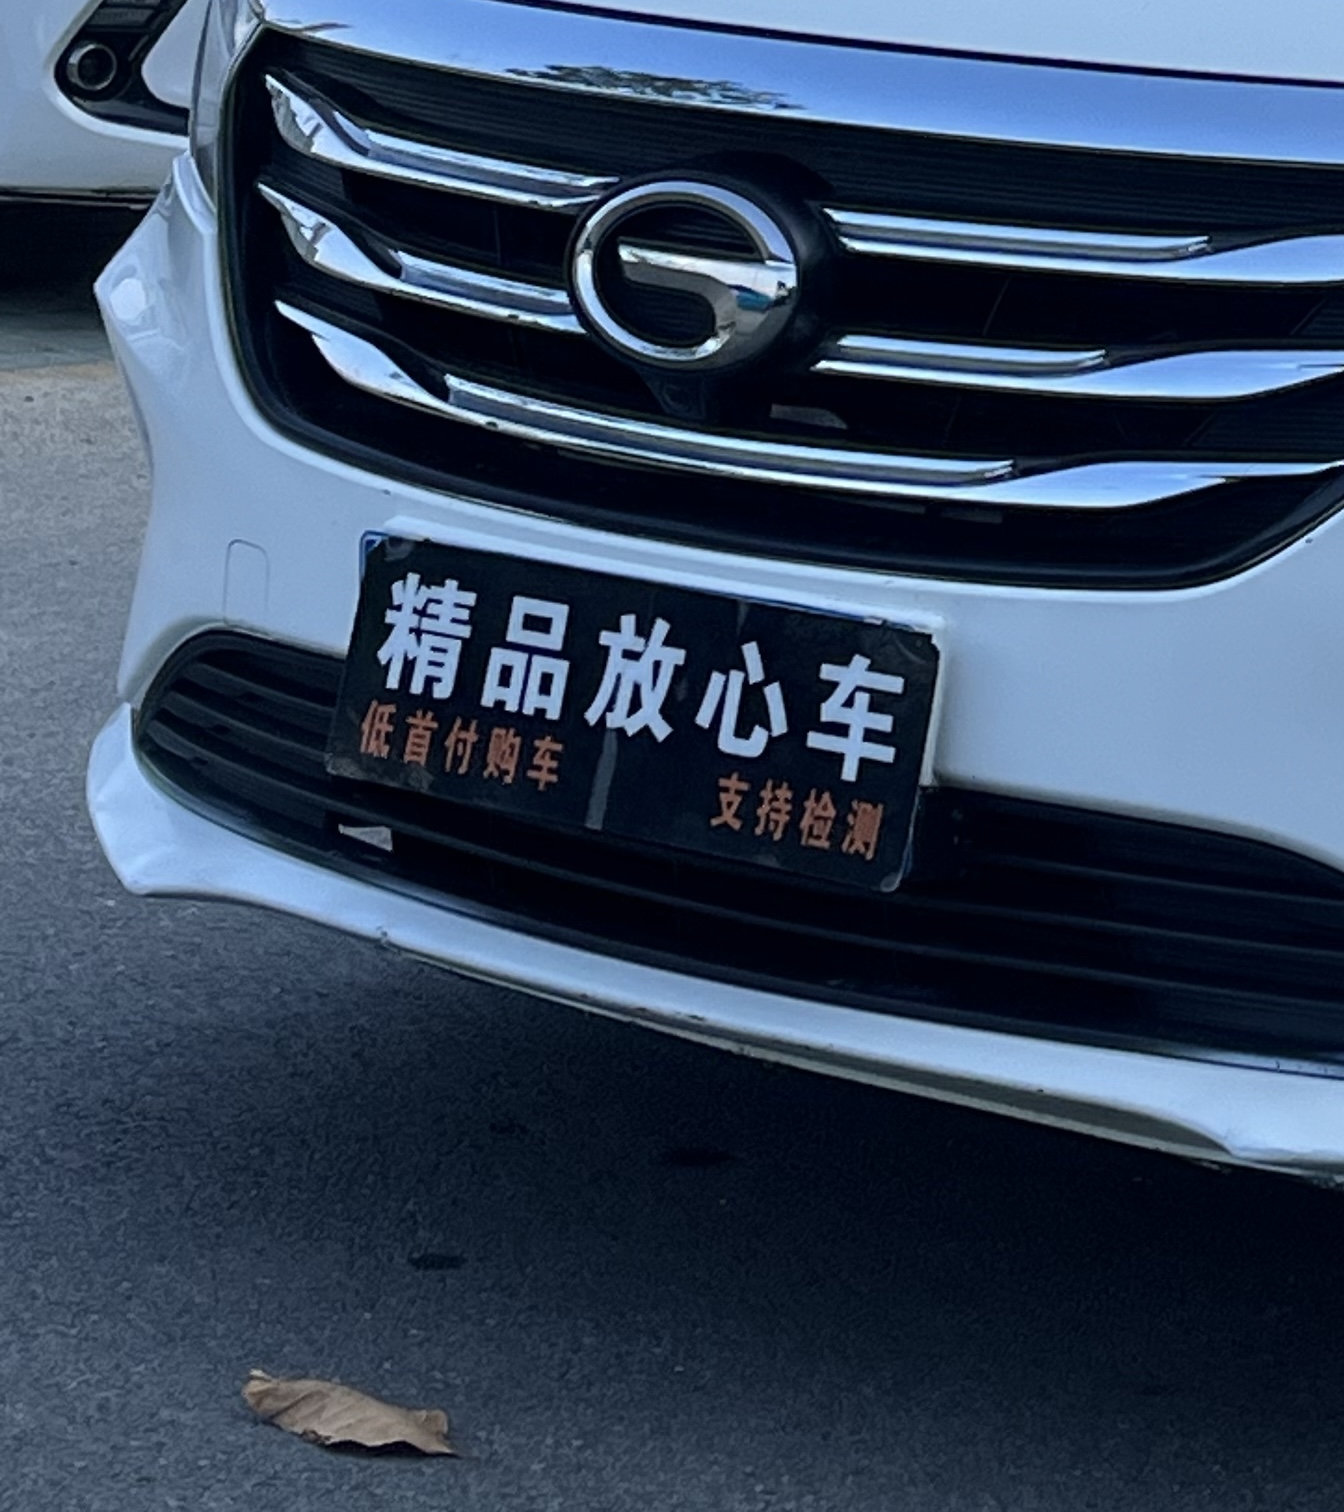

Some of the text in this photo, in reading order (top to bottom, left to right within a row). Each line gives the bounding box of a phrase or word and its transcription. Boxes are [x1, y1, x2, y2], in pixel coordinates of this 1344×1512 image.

[377, 572, 904, 782] 精品放心车
[359, 700, 883, 860] 低首付购车 支持检测
